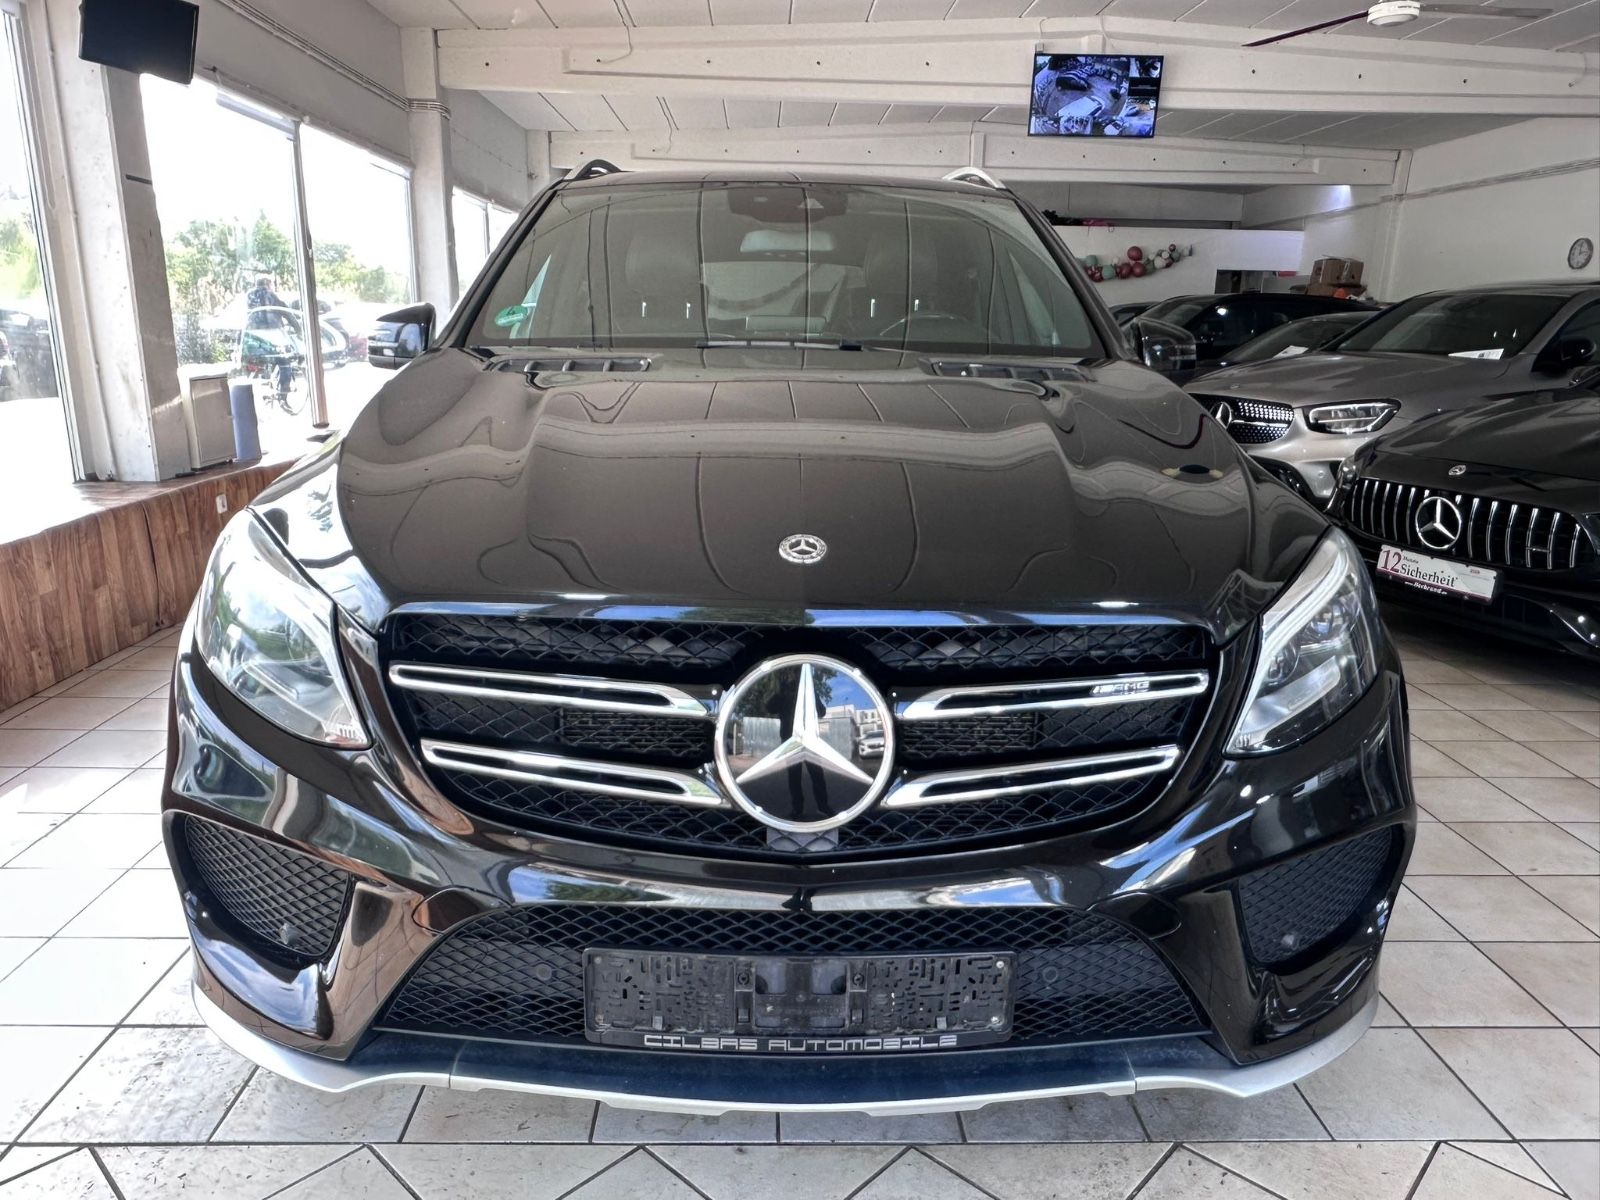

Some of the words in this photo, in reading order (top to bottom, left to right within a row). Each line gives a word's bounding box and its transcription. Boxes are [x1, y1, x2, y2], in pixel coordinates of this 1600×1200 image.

[1381, 549, 1403, 573] 12
[644, 1034, 758, 1050] CILBAS
[768, 1035, 957, 1051] AUTOMOBILE
